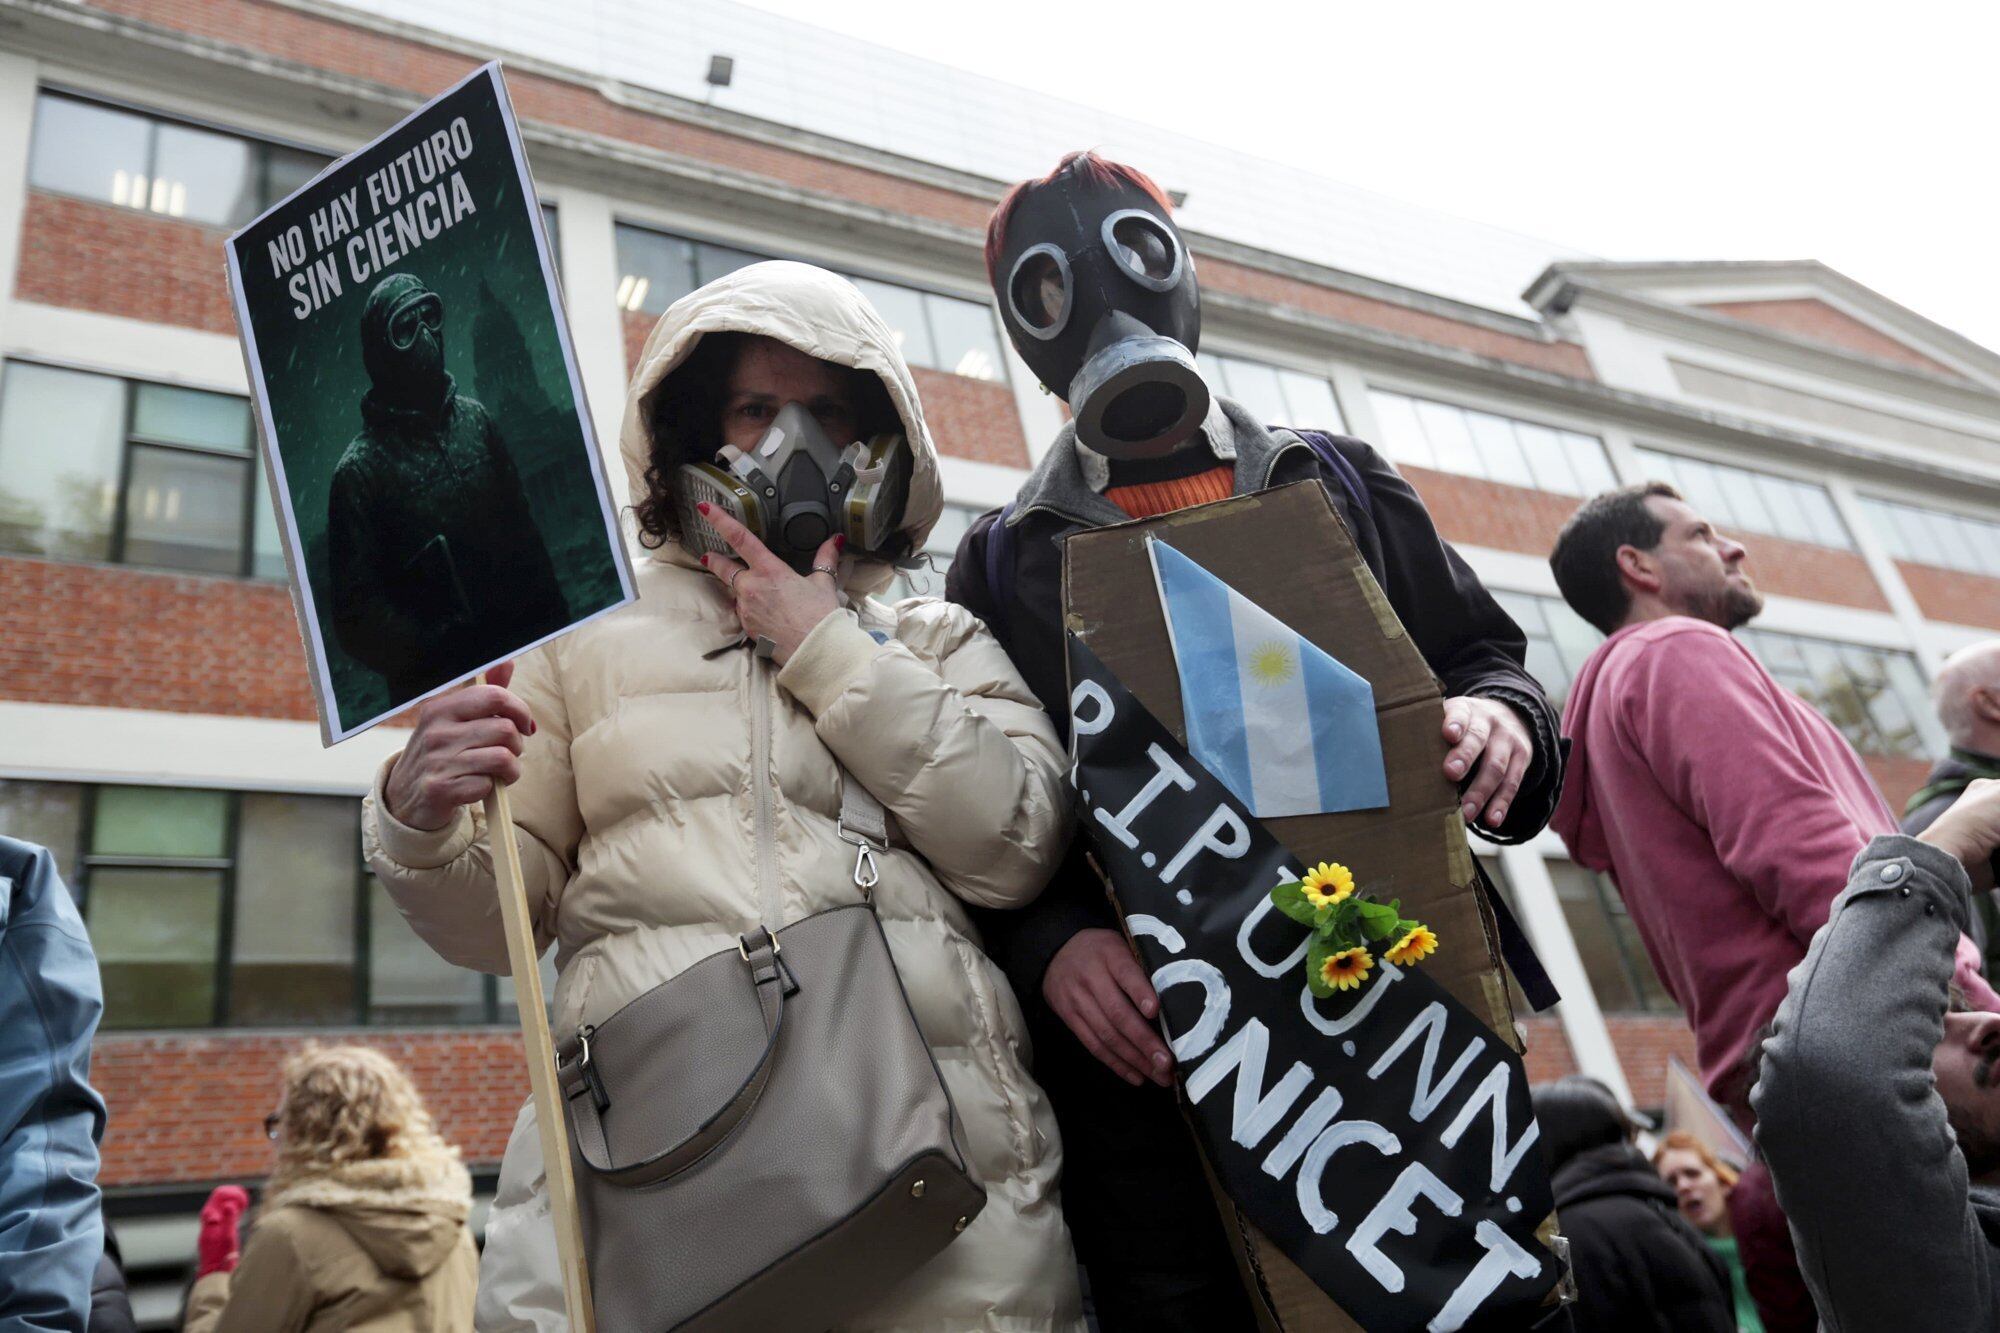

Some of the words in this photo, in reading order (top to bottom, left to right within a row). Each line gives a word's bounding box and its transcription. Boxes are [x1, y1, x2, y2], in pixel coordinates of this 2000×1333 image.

[267, 225, 307, 279] NO
[309, 186, 360, 252] HAY
[365, 116, 474, 216] FUTURO
[288, 252, 343, 320] SIN
[346, 170, 477, 284] CIENCIA
